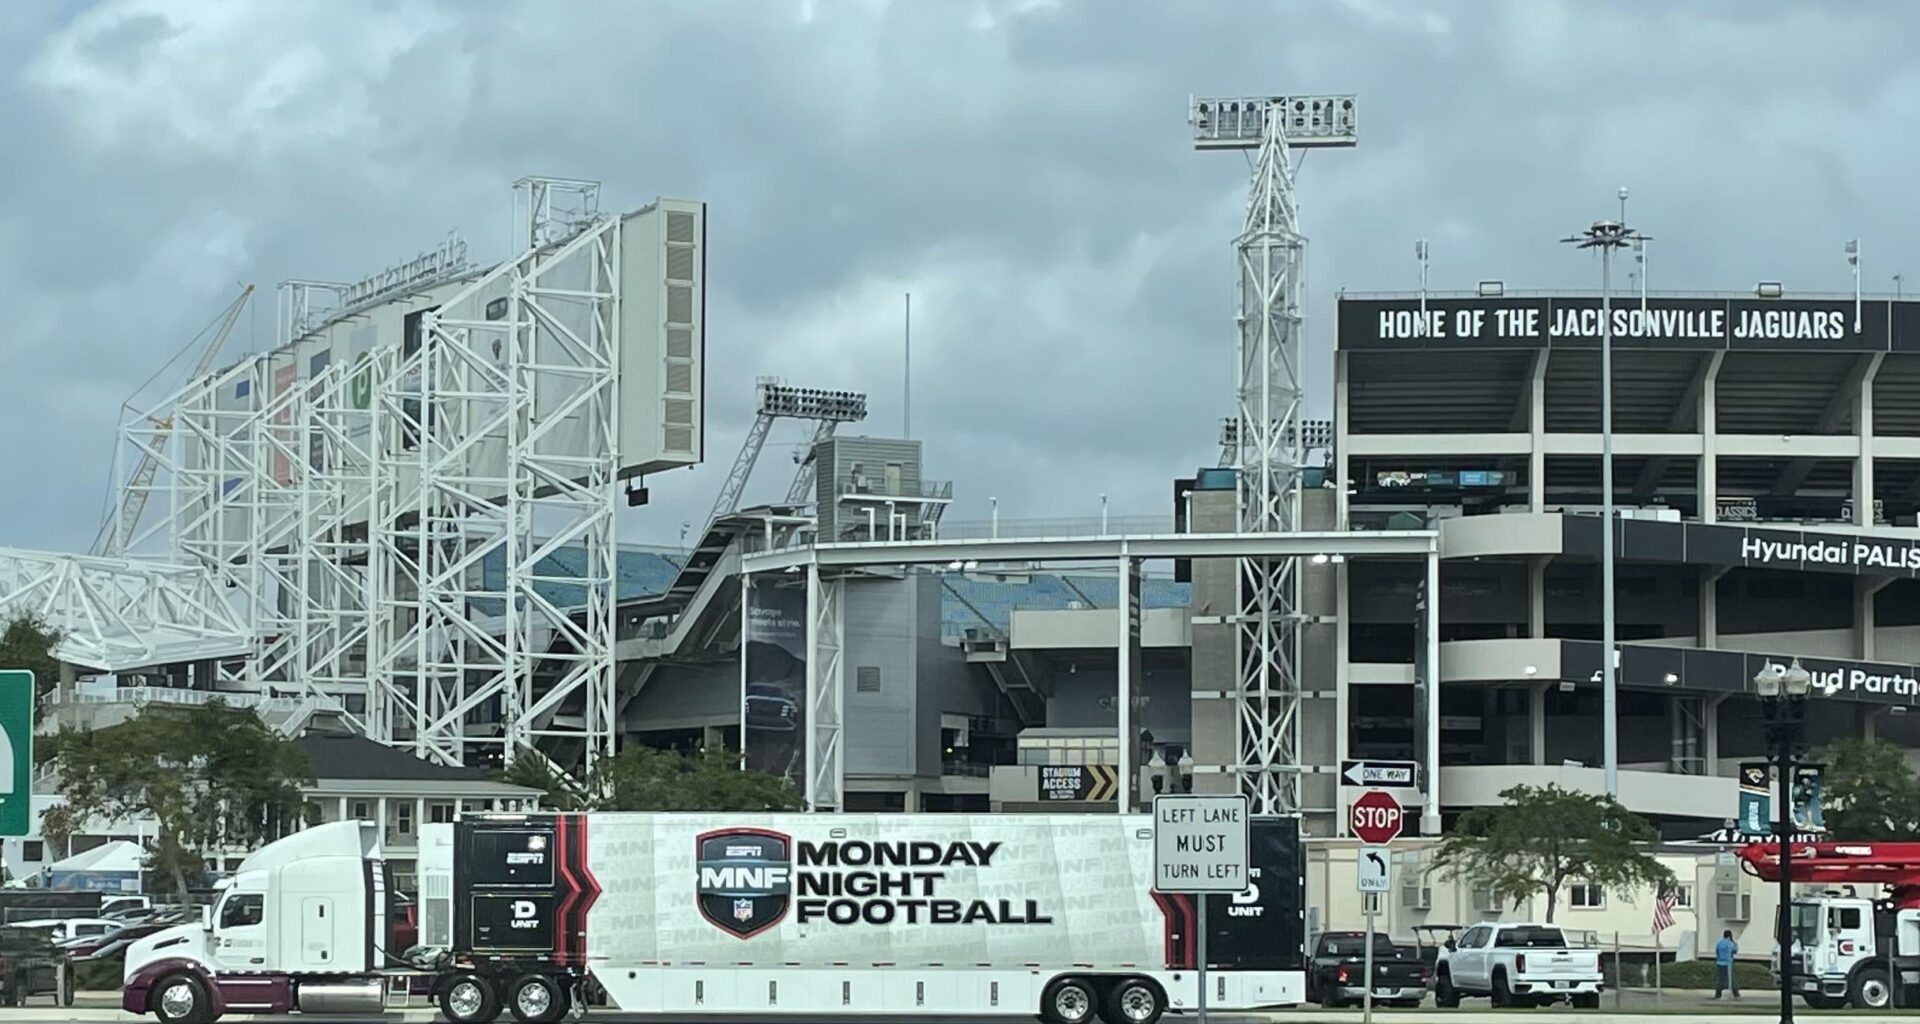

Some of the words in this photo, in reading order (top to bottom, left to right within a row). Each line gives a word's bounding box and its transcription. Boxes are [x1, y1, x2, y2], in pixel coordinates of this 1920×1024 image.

[1379, 310, 1446, 338] HOME
[1456, 310, 1485, 337] OF
[1494, 309, 1539, 337] THE
[1734, 311, 1844, 339] JAGUARS
[1742, 538, 1848, 563] Hyundai
[1771, 664, 1844, 690] Pud
[1850, 670, 1920, 695] Partn
[1042, 767, 1081, 778] STADIUM
[1363, 769, 1383, 779] ONE
[1386, 769, 1407, 779] WAY
[1042, 778, 1081, 790] ACCESS
[1163, 809, 1195, 822] LEFT
[1204, 809, 1240, 822] LANE
[1354, 807, 1399, 828] STOP
[725, 845, 762, 856] ESPN
[1177, 835, 1226, 852] MUST
[506, 853, 544, 864] ESPN
[797, 841, 1002, 866] MONDAY
[701, 867, 788, 889] MNF
[1163, 864, 1199, 878] TURN
[1208, 864, 1240, 878] LEFT
[797, 871, 944, 896] NIGHT
[1361, 879, 1387, 887] ONLY
[515, 901, 536, 918] D
[797, 899, 1053, 925] FOOTBALL
[1228, 907, 1263, 916] UNIT
[511, 920, 539, 928] UNIT
